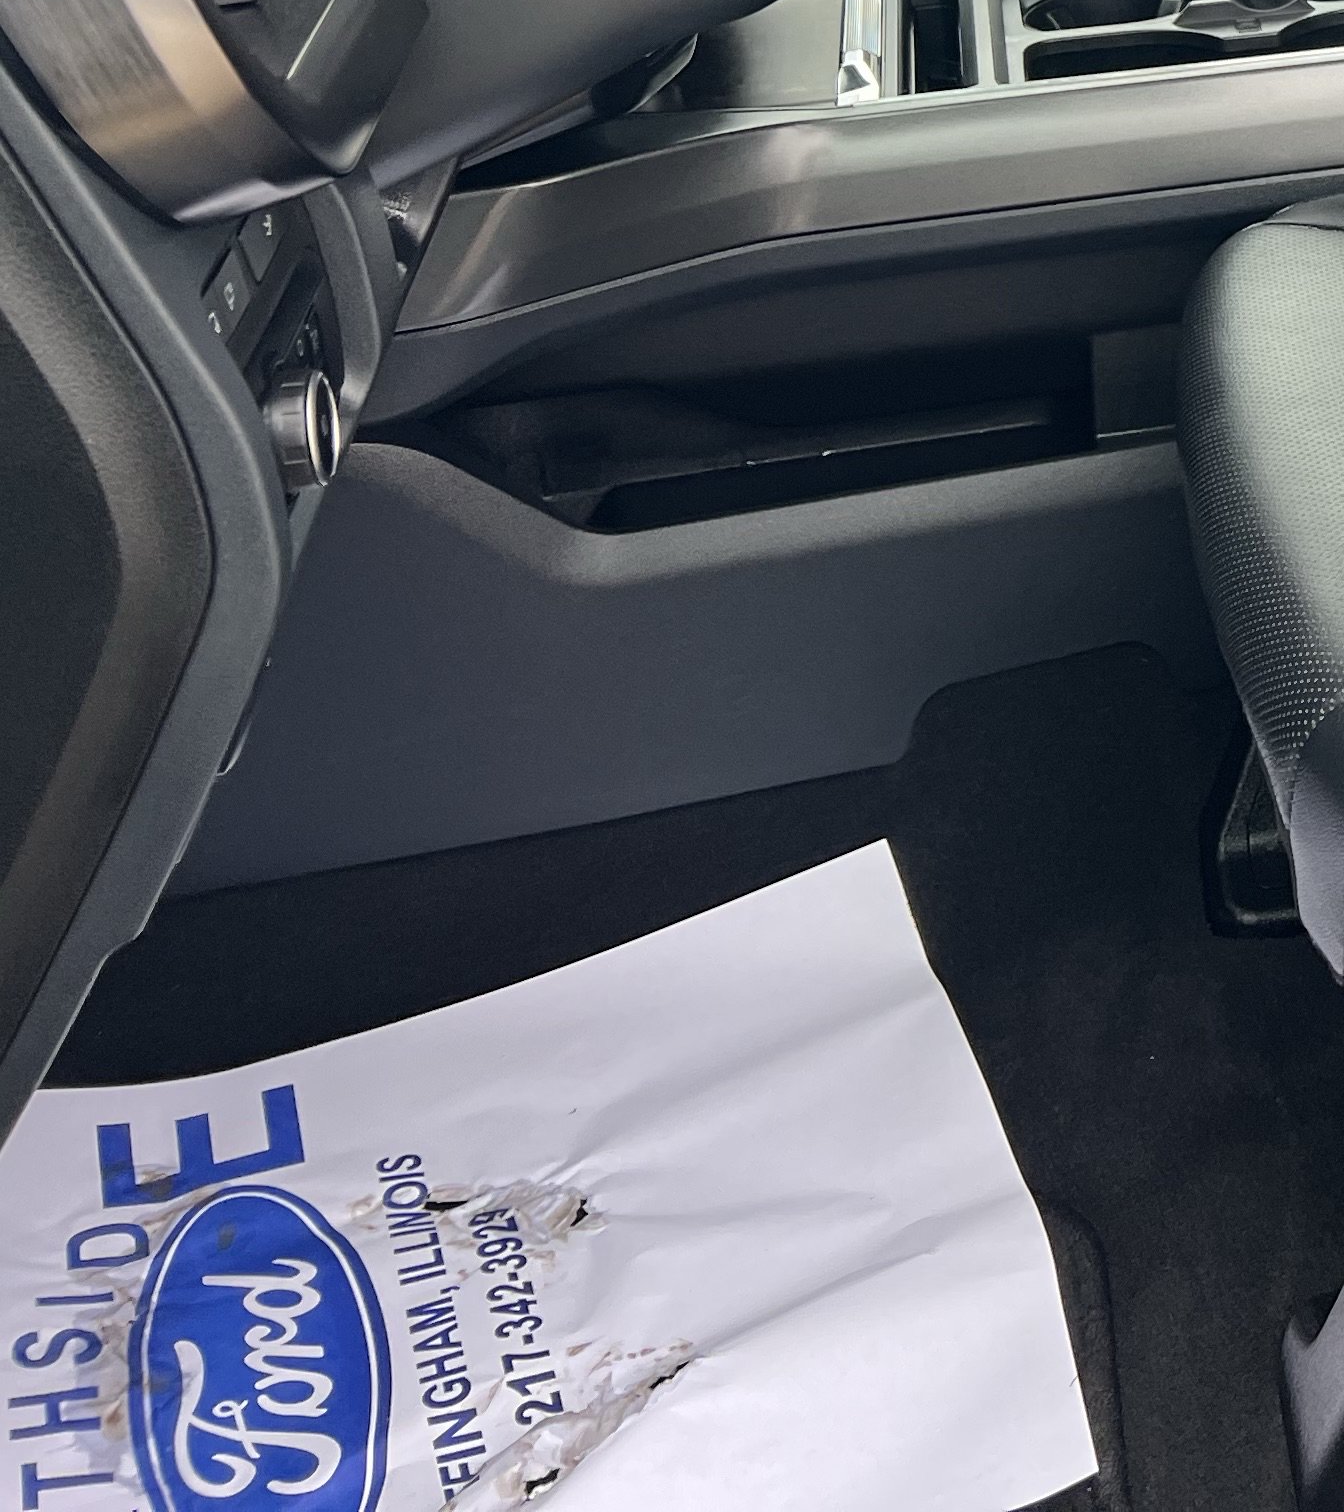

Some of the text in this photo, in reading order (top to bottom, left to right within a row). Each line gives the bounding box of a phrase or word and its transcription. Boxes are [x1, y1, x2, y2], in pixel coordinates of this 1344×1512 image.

[8, 1084, 306, 1512] THSIDE
[376, 1154, 447, 1286] ILLINOIS
[172, 1259, 343, 1498] Ford
